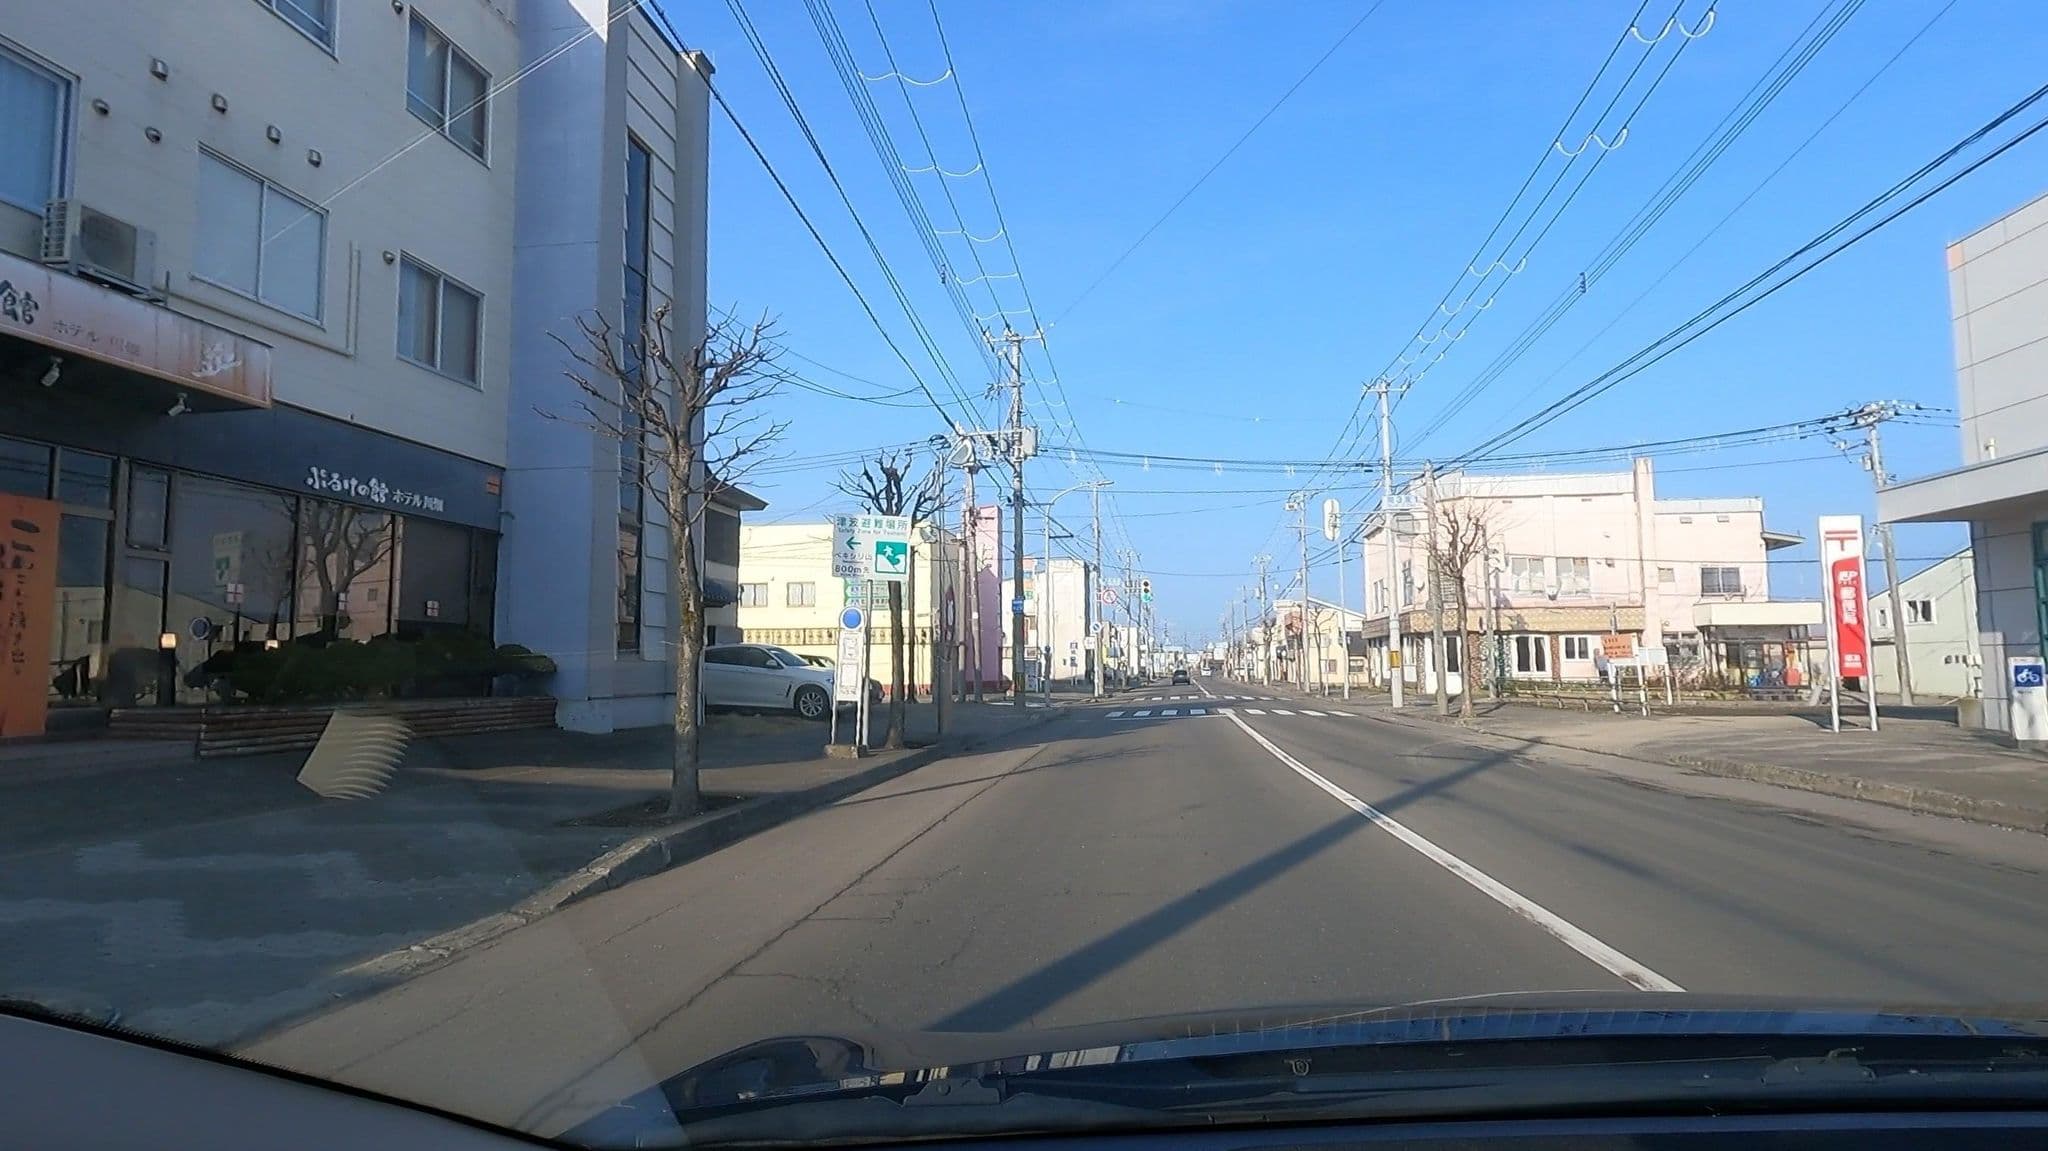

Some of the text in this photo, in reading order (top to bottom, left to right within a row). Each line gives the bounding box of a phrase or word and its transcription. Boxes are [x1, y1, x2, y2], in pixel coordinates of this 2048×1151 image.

[837, 516, 907, 530] 津波避難場所
